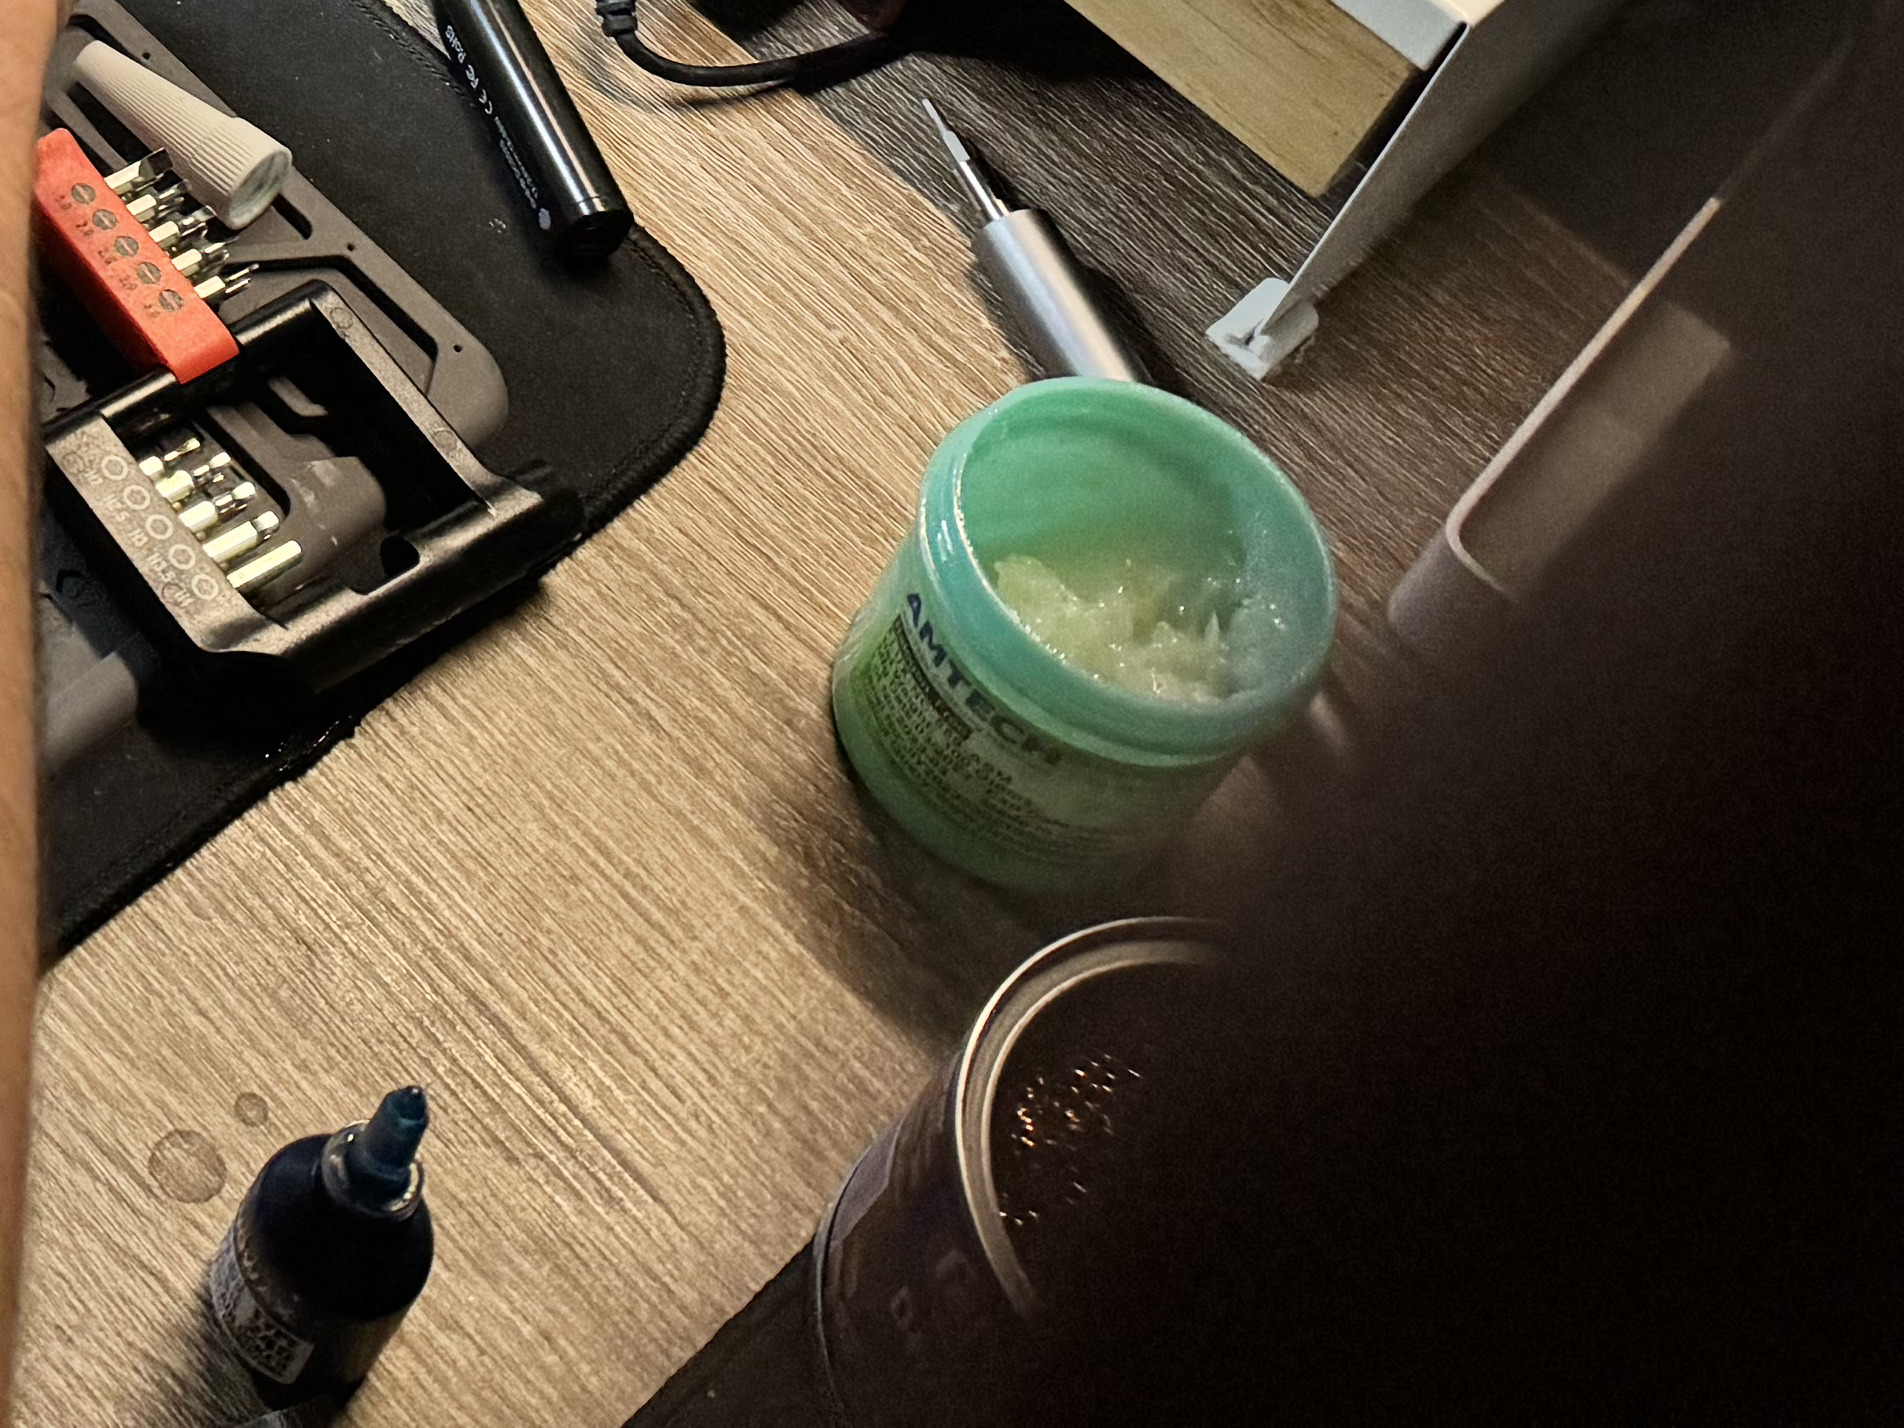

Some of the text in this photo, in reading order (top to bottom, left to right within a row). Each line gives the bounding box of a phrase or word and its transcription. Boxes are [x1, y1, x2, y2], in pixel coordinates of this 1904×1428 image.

[479, 89, 493, 115] CE
[131, 526, 149, 548] H3
[147, 553, 177, 584] H3.5
[906, 593, 1062, 766] AMTECH
